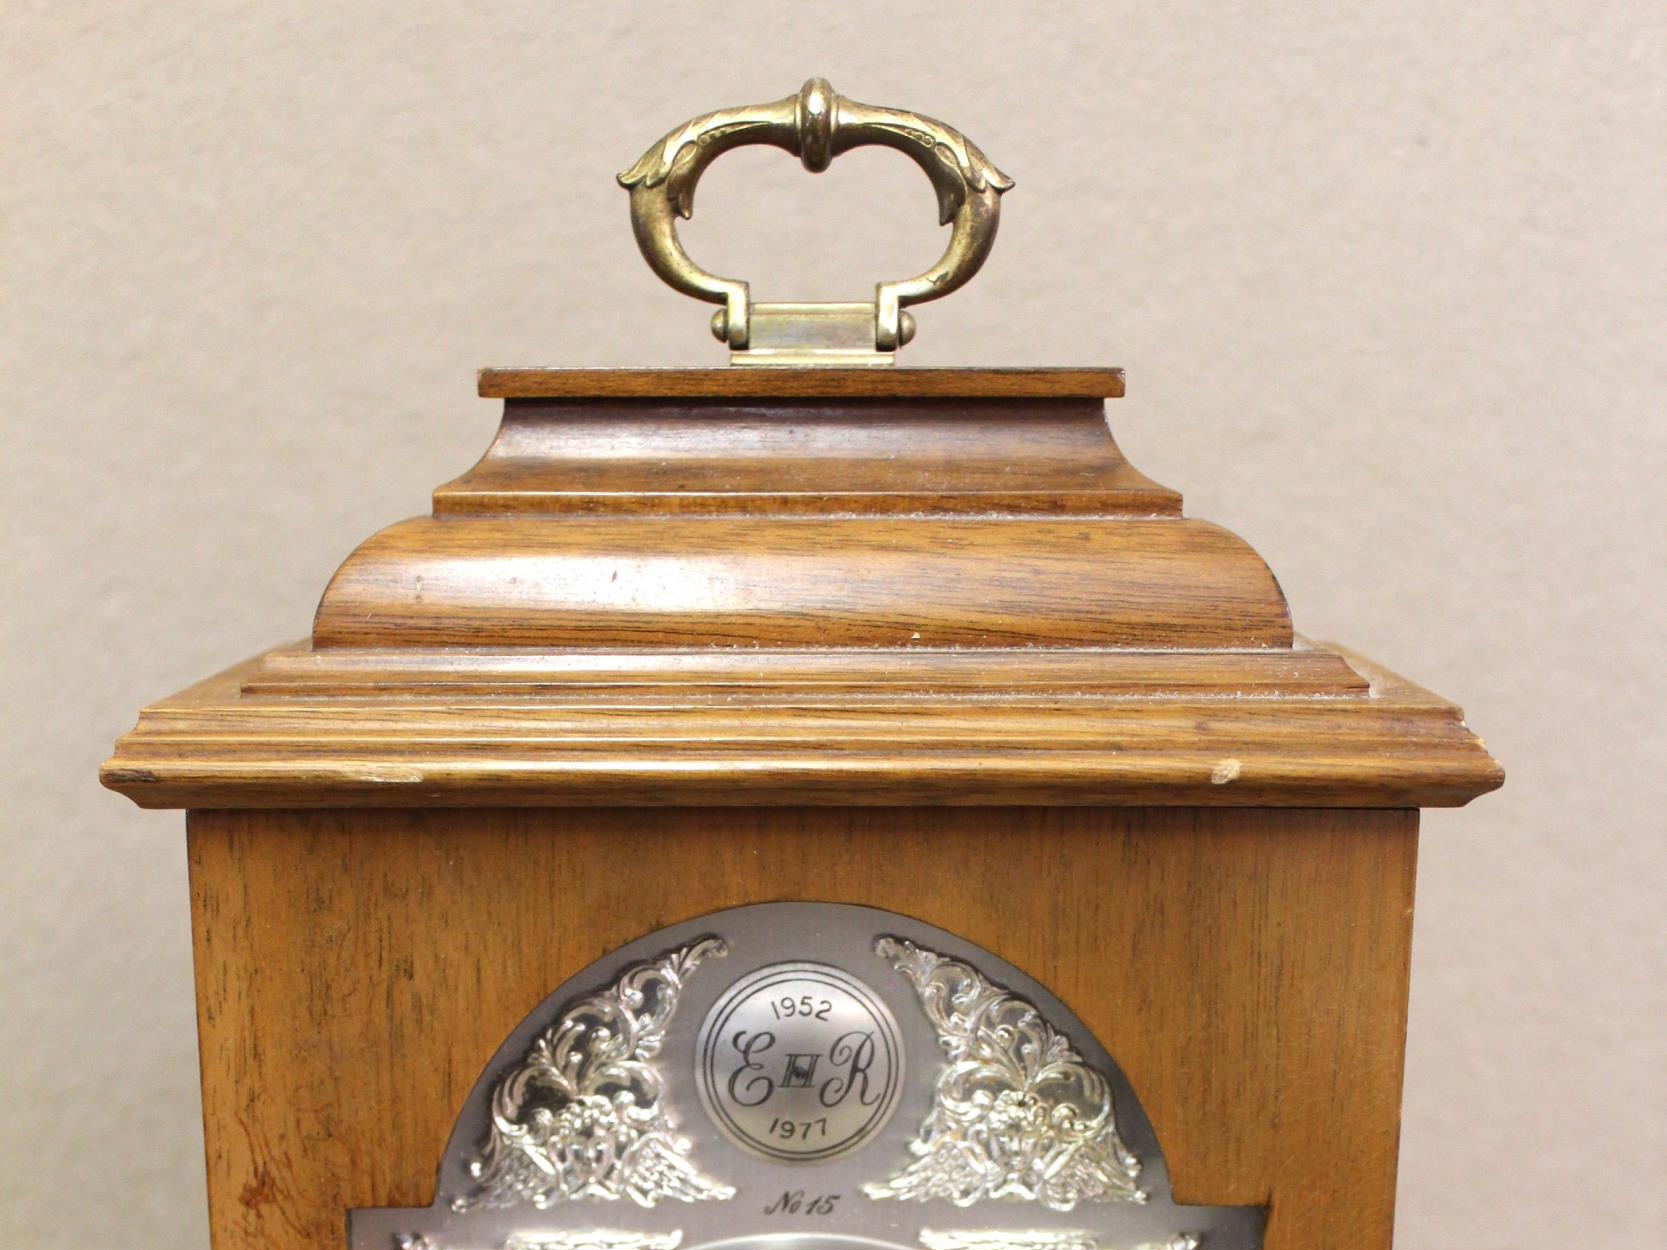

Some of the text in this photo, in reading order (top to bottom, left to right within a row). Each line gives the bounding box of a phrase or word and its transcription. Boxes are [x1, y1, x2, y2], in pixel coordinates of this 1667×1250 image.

[771, 996, 833, 1022] 1952
[728, 1030, 776, 1107] E
[819, 1030, 881, 1108] R
[769, 1117, 828, 1140] 1977
[805, 1195, 842, 1216] 15
